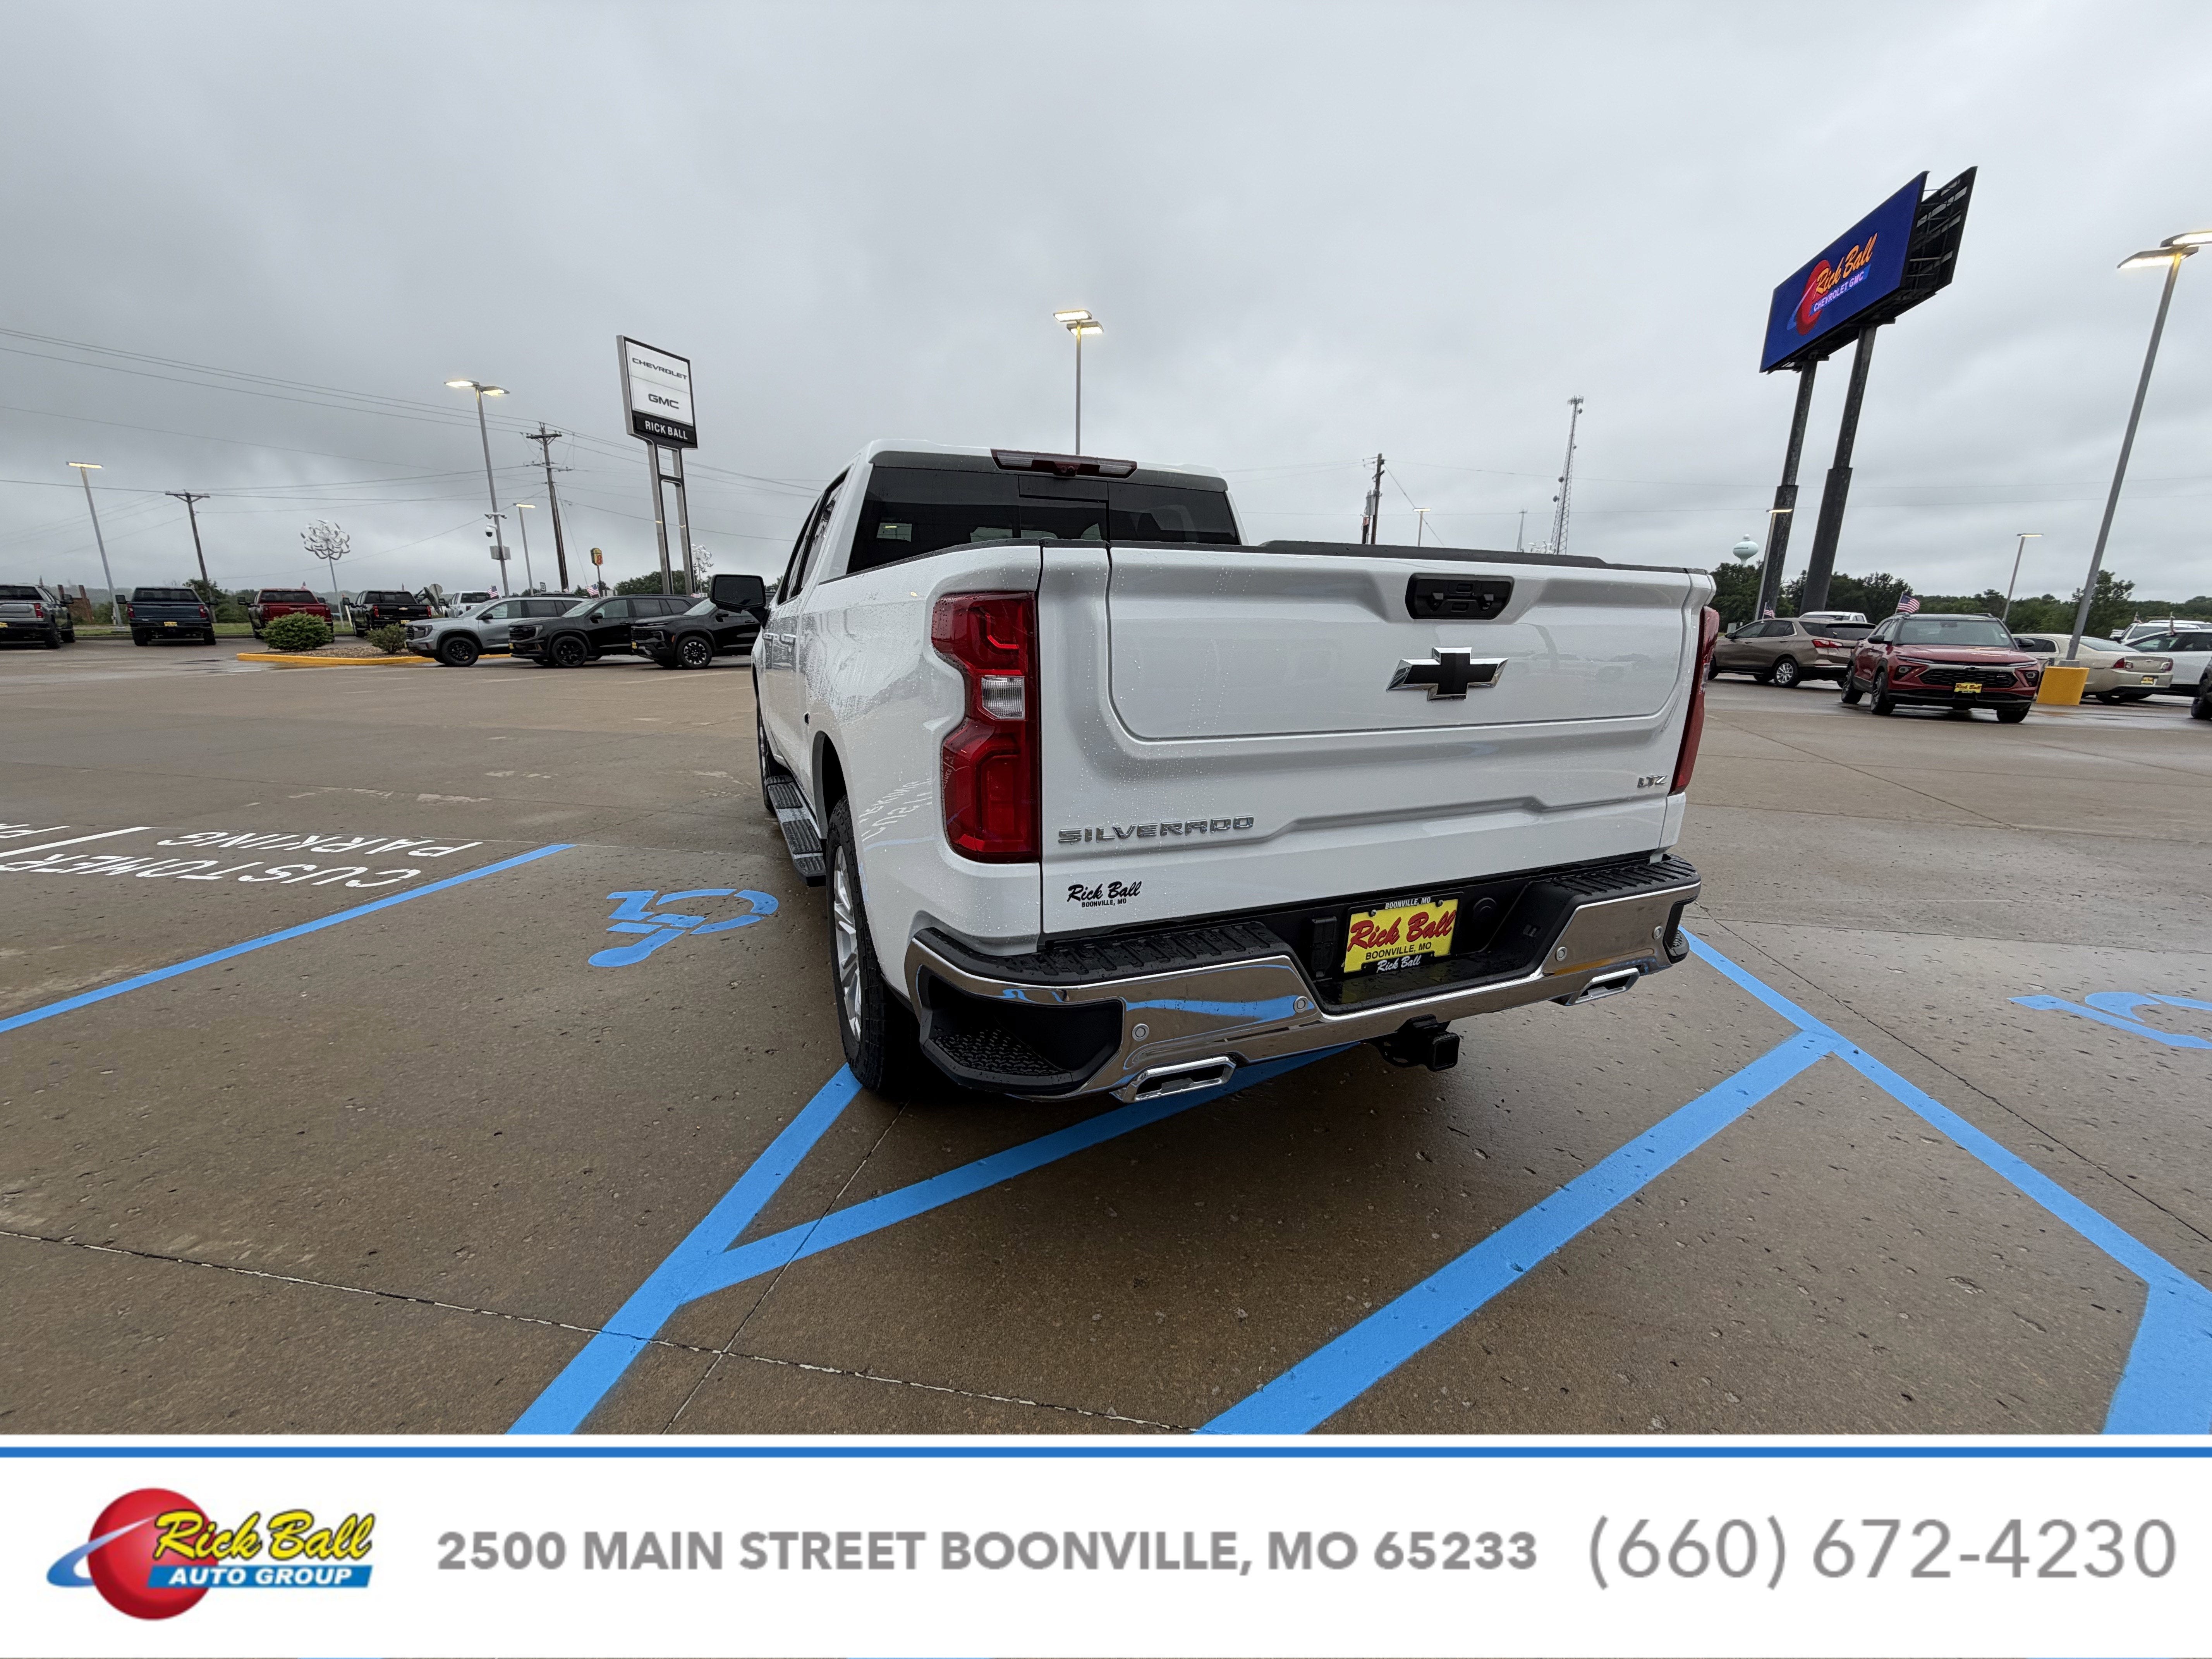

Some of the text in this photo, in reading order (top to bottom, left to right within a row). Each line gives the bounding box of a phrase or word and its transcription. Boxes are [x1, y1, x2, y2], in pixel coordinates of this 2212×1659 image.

[1812, 233, 1877, 301] Rick Ball
[1814, 271, 1864, 312] CHEVROLET GMC
[632, 357, 687, 380] CHEVROLET
[648, 393, 679, 409] GMC
[644, 420, 688, 440] RICK BALL
[1637, 775, 1668, 788] LTZ
[1058, 815, 1254, 843] SILVERADO
[157, 832, 483, 857] PARKING
[0, 853, 421, 887] CUSTOMER
[1067, 881, 1142, 902] Rick Ball
[1082, 899, 1115, 907] BOONVILLE,
[1385, 898, 1419, 909] BOONVILLE,
[1347, 910, 1456, 952] Rick Ball
[1365, 942, 1432, 960] BOONVILLE, MO
[1376, 955, 1422, 973] Rick Ball
